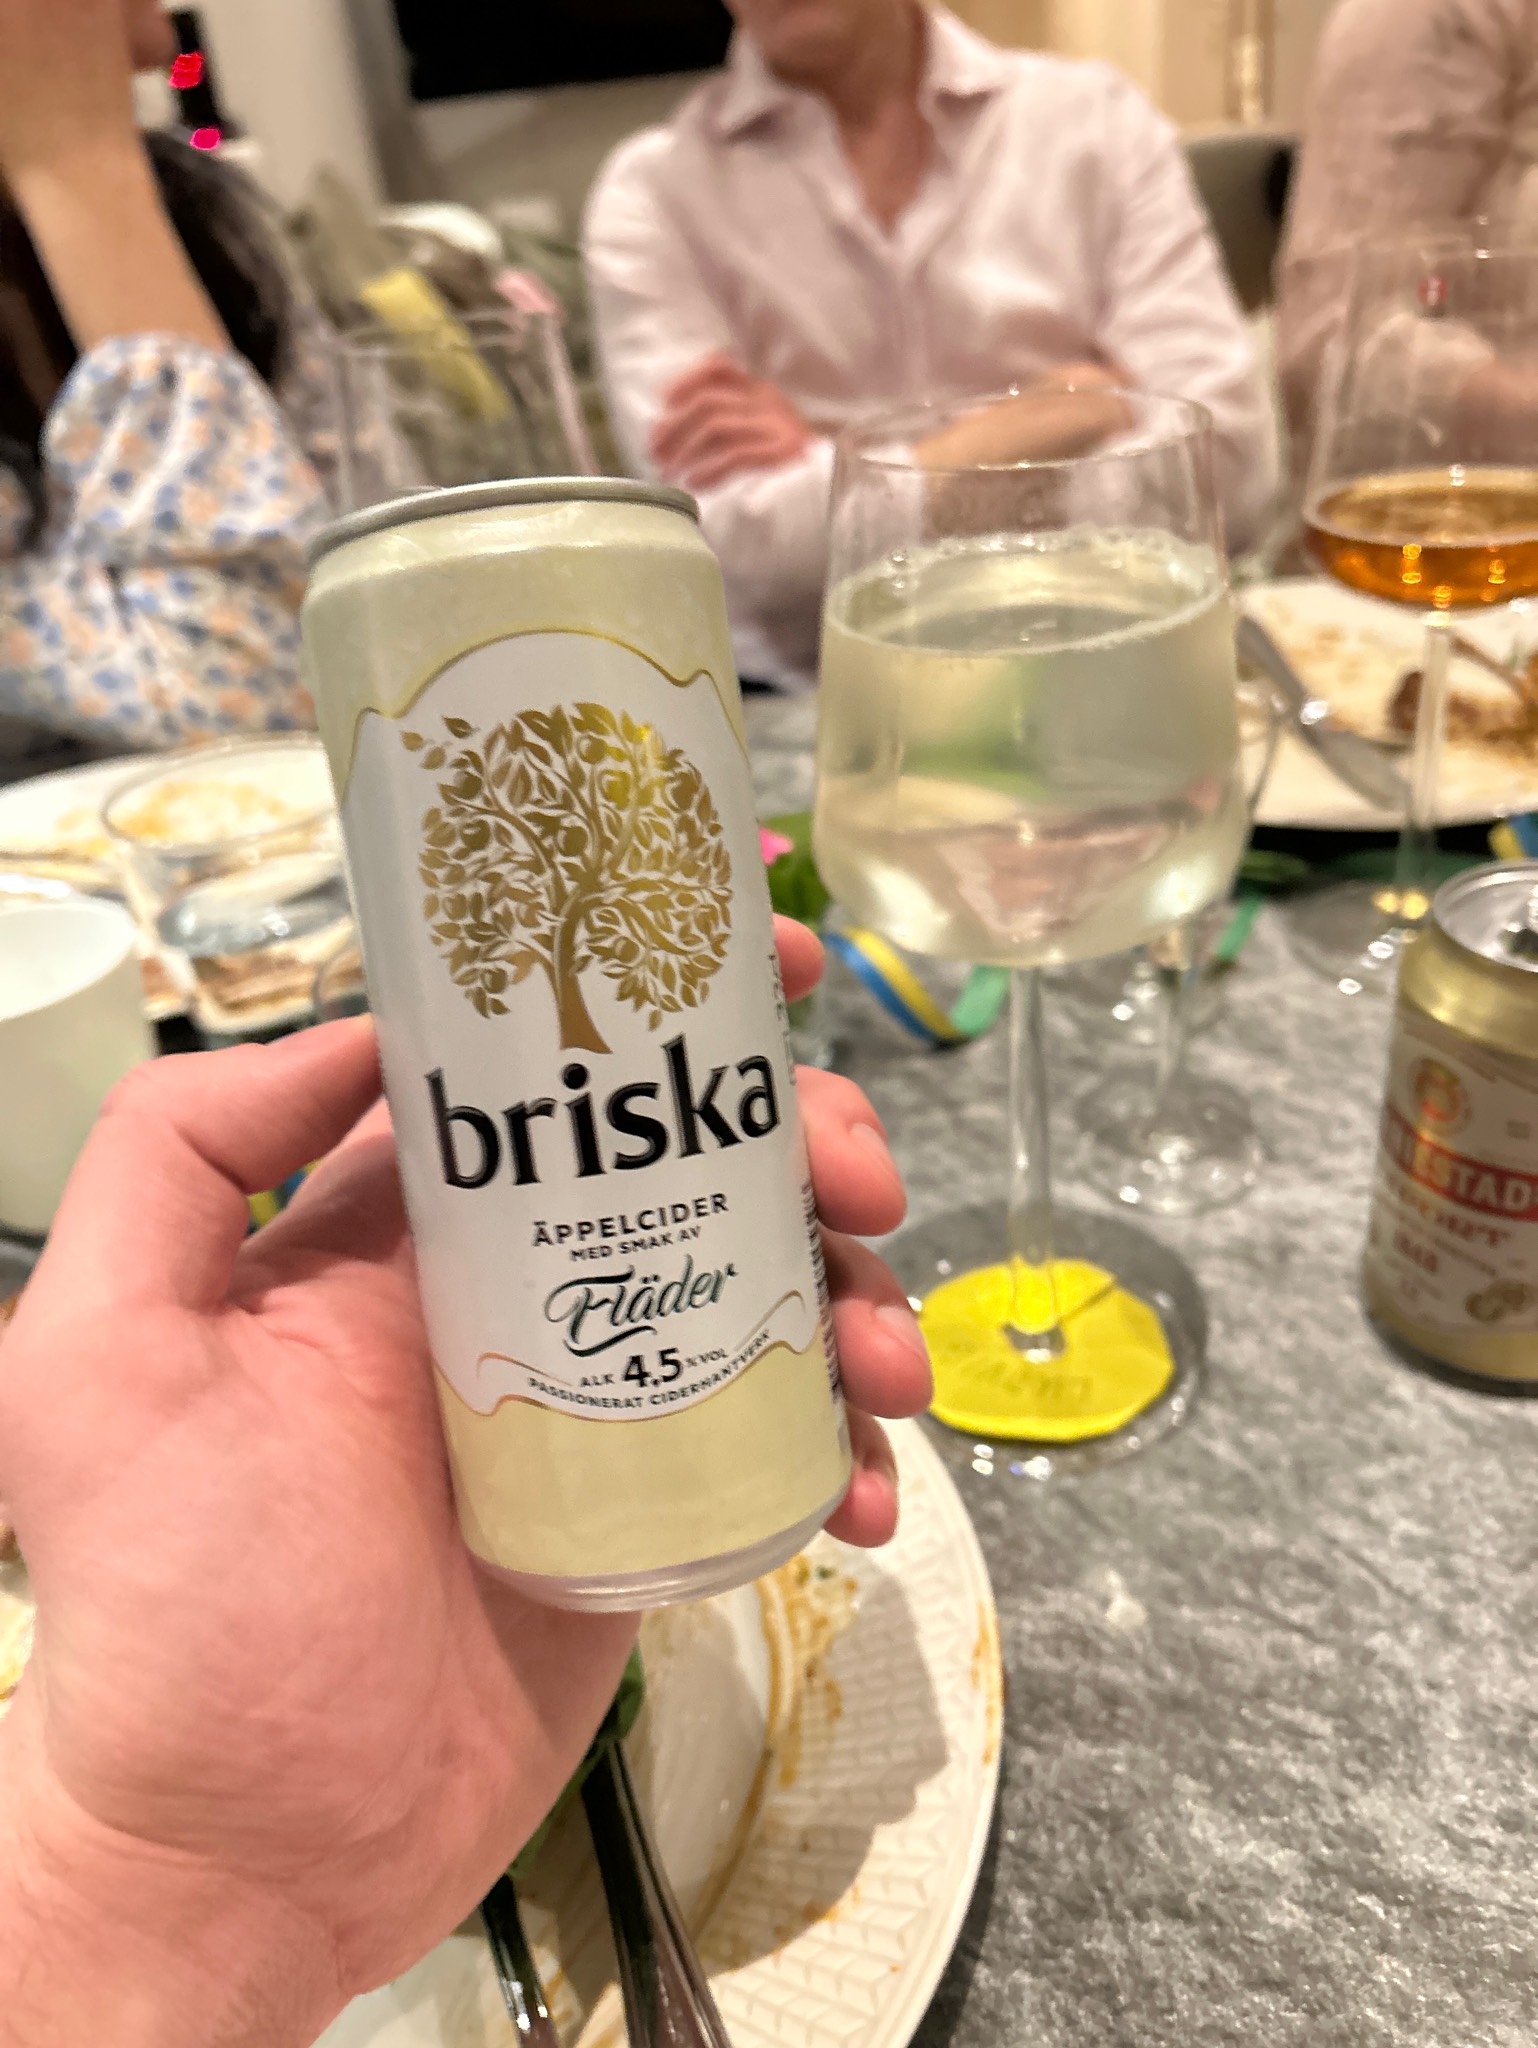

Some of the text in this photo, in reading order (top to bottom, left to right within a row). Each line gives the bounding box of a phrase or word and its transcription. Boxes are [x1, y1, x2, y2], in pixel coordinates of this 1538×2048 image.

[425, 1033, 780, 1189] briska
[532, 1193, 729, 1247] ÄPPELCIDER
[569, 1226, 701, 1262] MED SMAK AV
[544, 1253, 738, 1357] Fläder
[528, 1377, 643, 1409] PASSIONERAT
[580, 1374, 615, 1388] ALK
